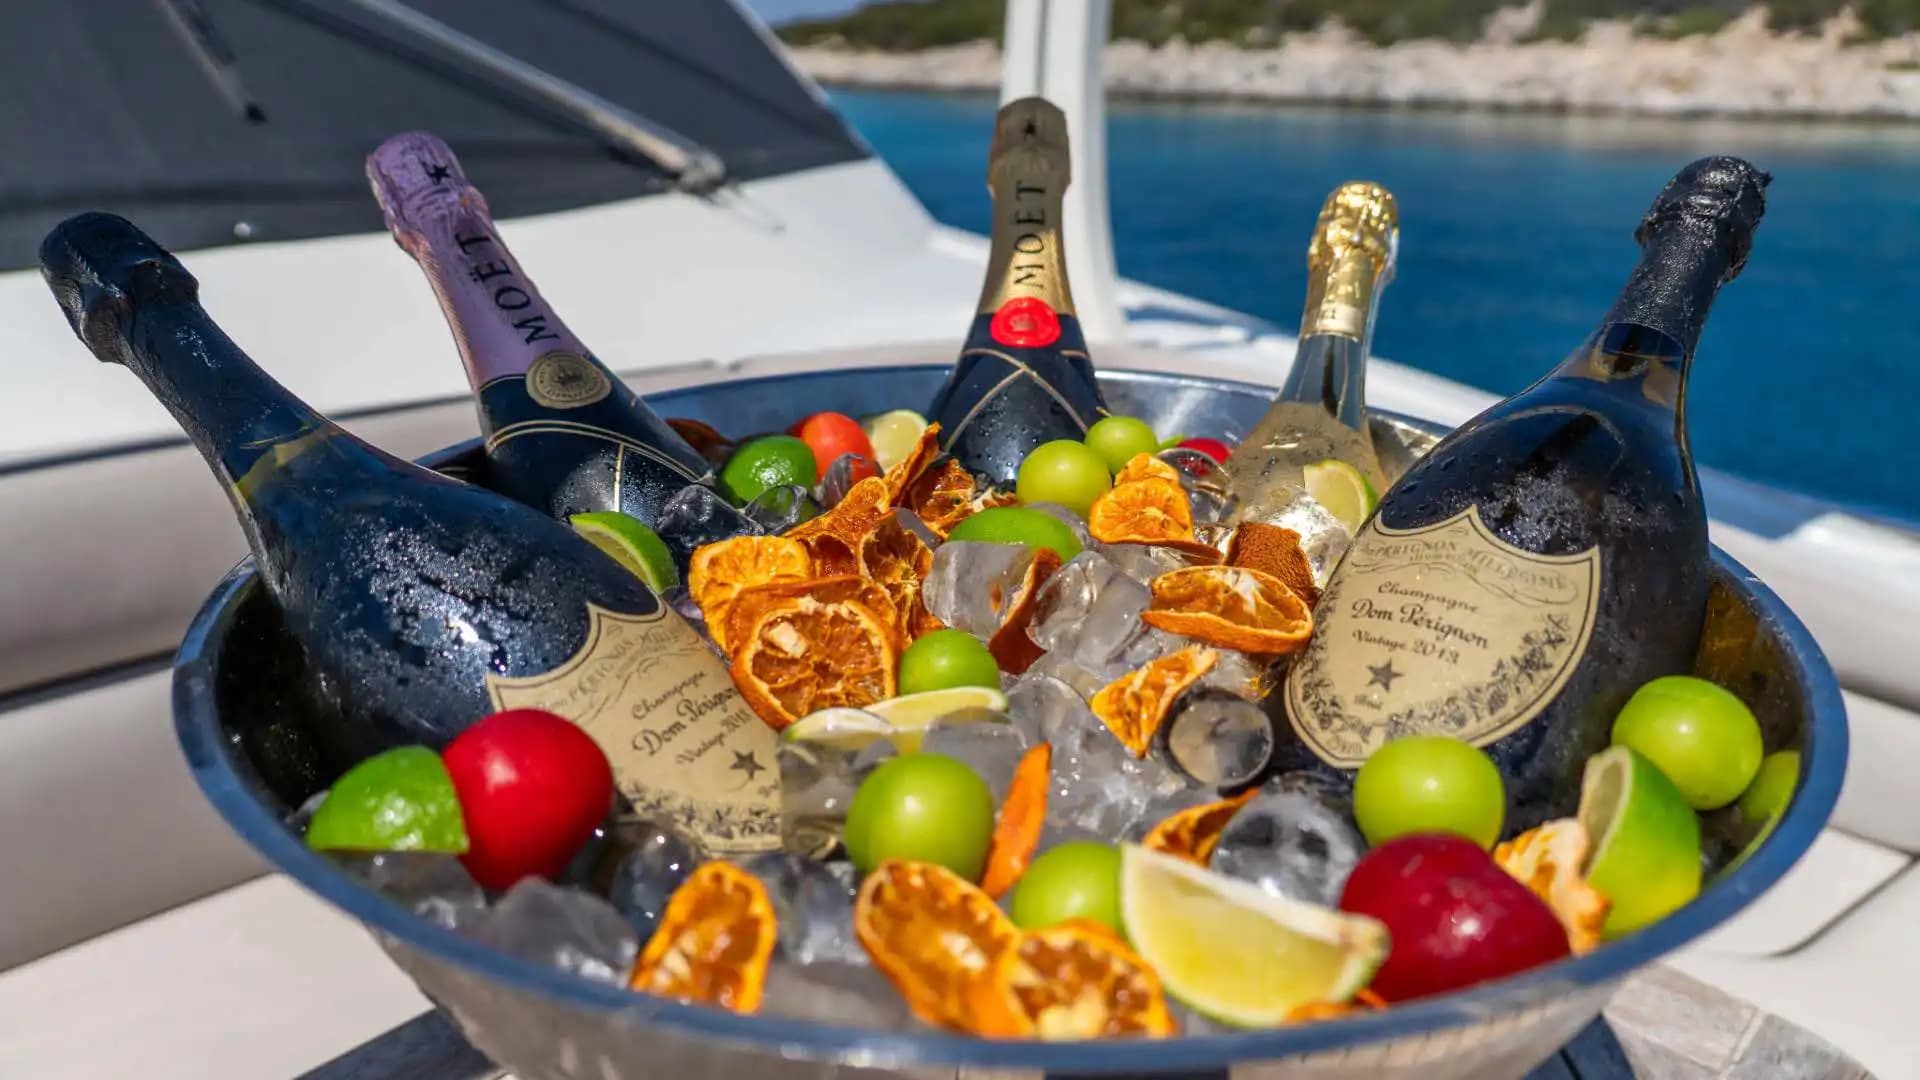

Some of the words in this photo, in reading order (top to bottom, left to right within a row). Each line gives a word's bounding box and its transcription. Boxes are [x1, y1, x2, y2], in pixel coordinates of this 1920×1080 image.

[455, 232, 561, 345] MOËT
[1377, 580, 1480, 614] Champagne
[1352, 598, 1393, 621] Dom
[1400, 603, 1489, 649] Pérignon
[1352, 628, 1406, 652] Vintage
[631, 669, 708, 721] Champagne
[632, 721, 687, 757] Dom
